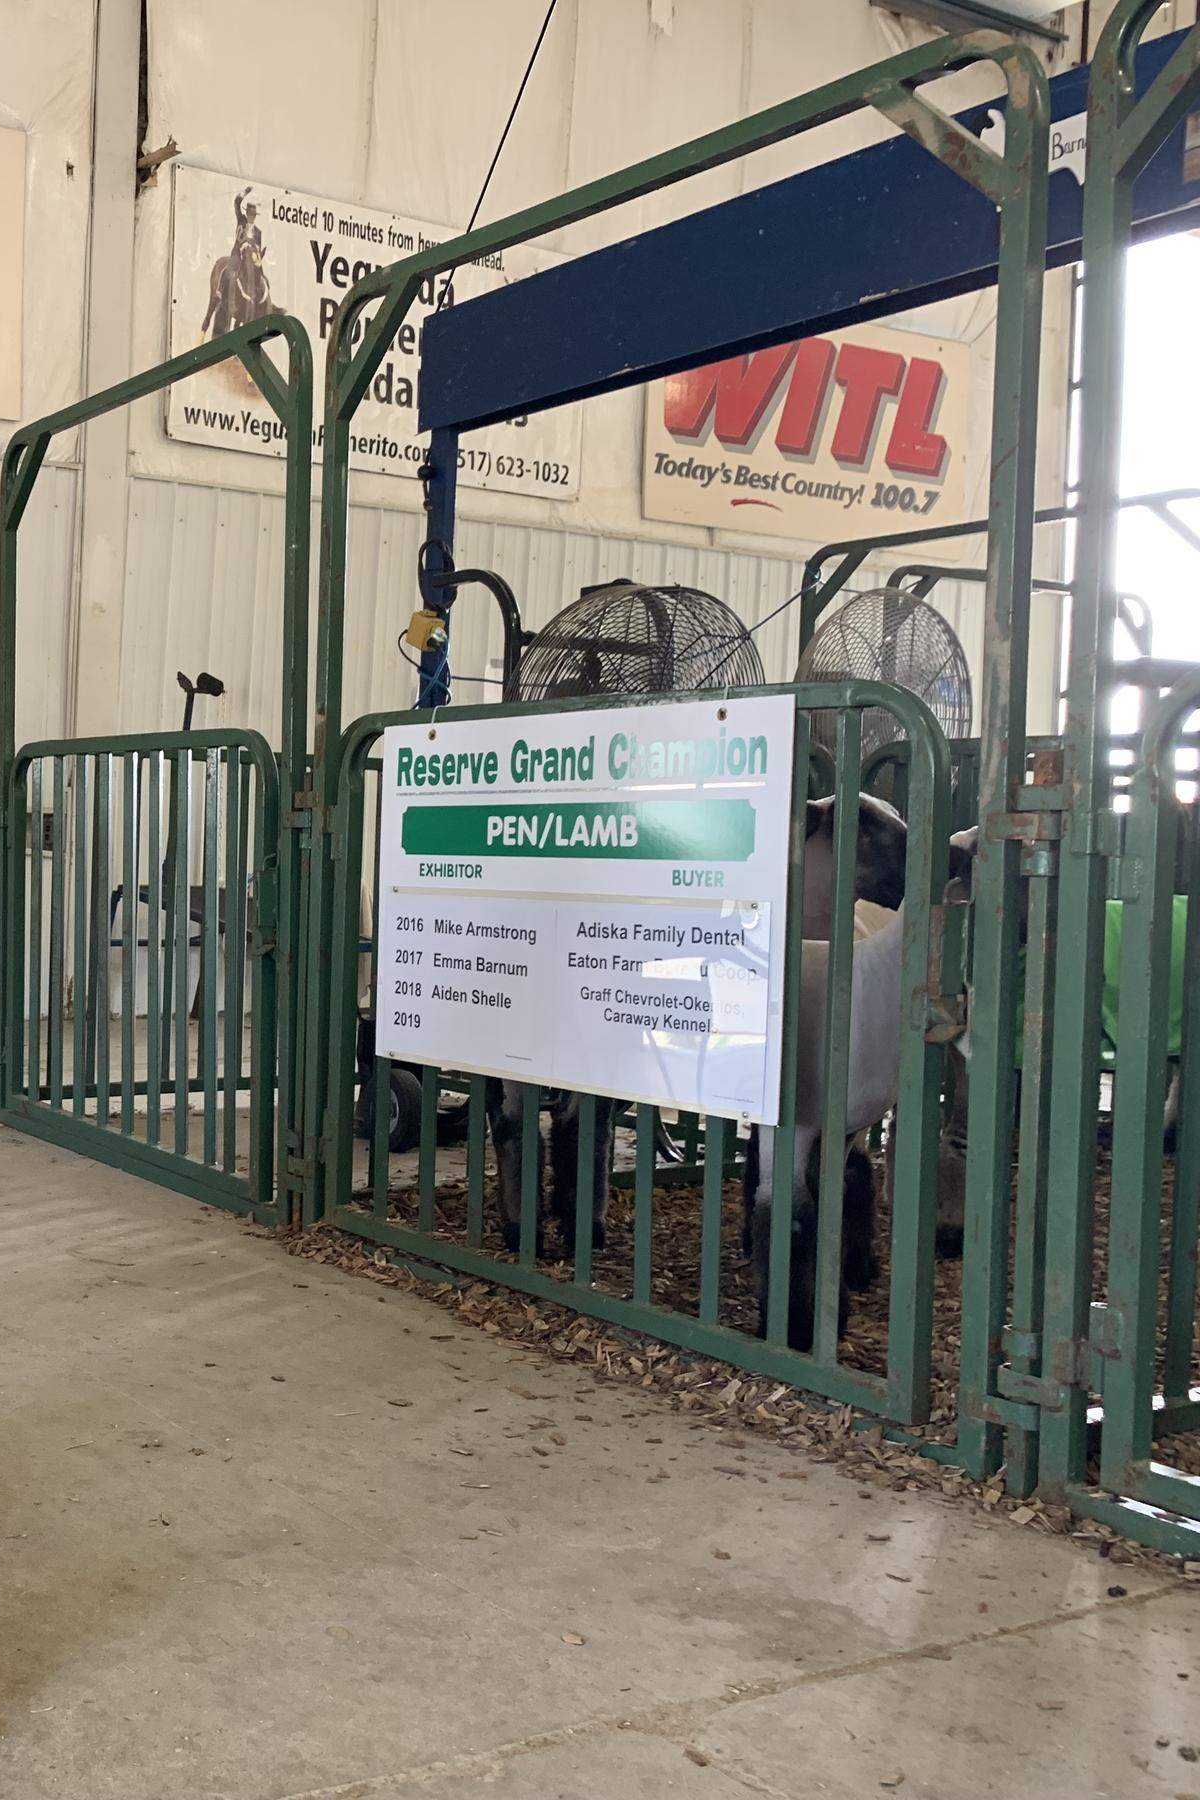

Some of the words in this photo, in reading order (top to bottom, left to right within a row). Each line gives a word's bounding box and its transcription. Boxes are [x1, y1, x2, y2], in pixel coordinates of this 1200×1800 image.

[1052, 132, 1087, 160] Barn
[272, 198, 317, 229] Located
[322, 211, 333, 232] 10
[339, 216, 383, 244] minutes
[388, 225, 413, 251] from
[664, 336, 951, 485] WITL
[458, 448, 491, 477] 517)
[496, 455, 569, 485] 623-1032
[654, 452, 732, 488] Today's
[734, 465, 780, 491] Best
[781, 473, 865, 509] Country!
[871, 483, 940, 515] 100.7
[396, 746, 498, 787] Reserve
[510, 735, 595, 784] Grand
[608, 727, 768, 786] Champion
[487, 812, 638, 849] PEN/LAMB
[419, 863, 483, 880] EXHIBITOR
[672, 869, 724, 888] BUYER
[396, 916, 424, 933] 2016
[434, 918, 463, 936] Mike
[466, 922, 537, 945] Armstrong
[576, 922, 628, 940] Adiska
[633, 924, 685, 947] Family
[691, 926, 745, 946] Dental
[395, 949, 423, 966] 2017
[433, 953, 473, 971] Emma
[476, 957, 528, 978] Barnum
[568, 953, 607, 970] Eaton
[395, 980, 422, 998] 2018
[431, 984, 467, 1002] Aiden
[471, 990, 512, 1009] Shelle
[580, 987, 611, 1002] Graff
[394, 1011, 421, 1029] 2019
[604, 1008, 659, 1030] Caraway
[663, 1014, 718, 1033] Kennels
